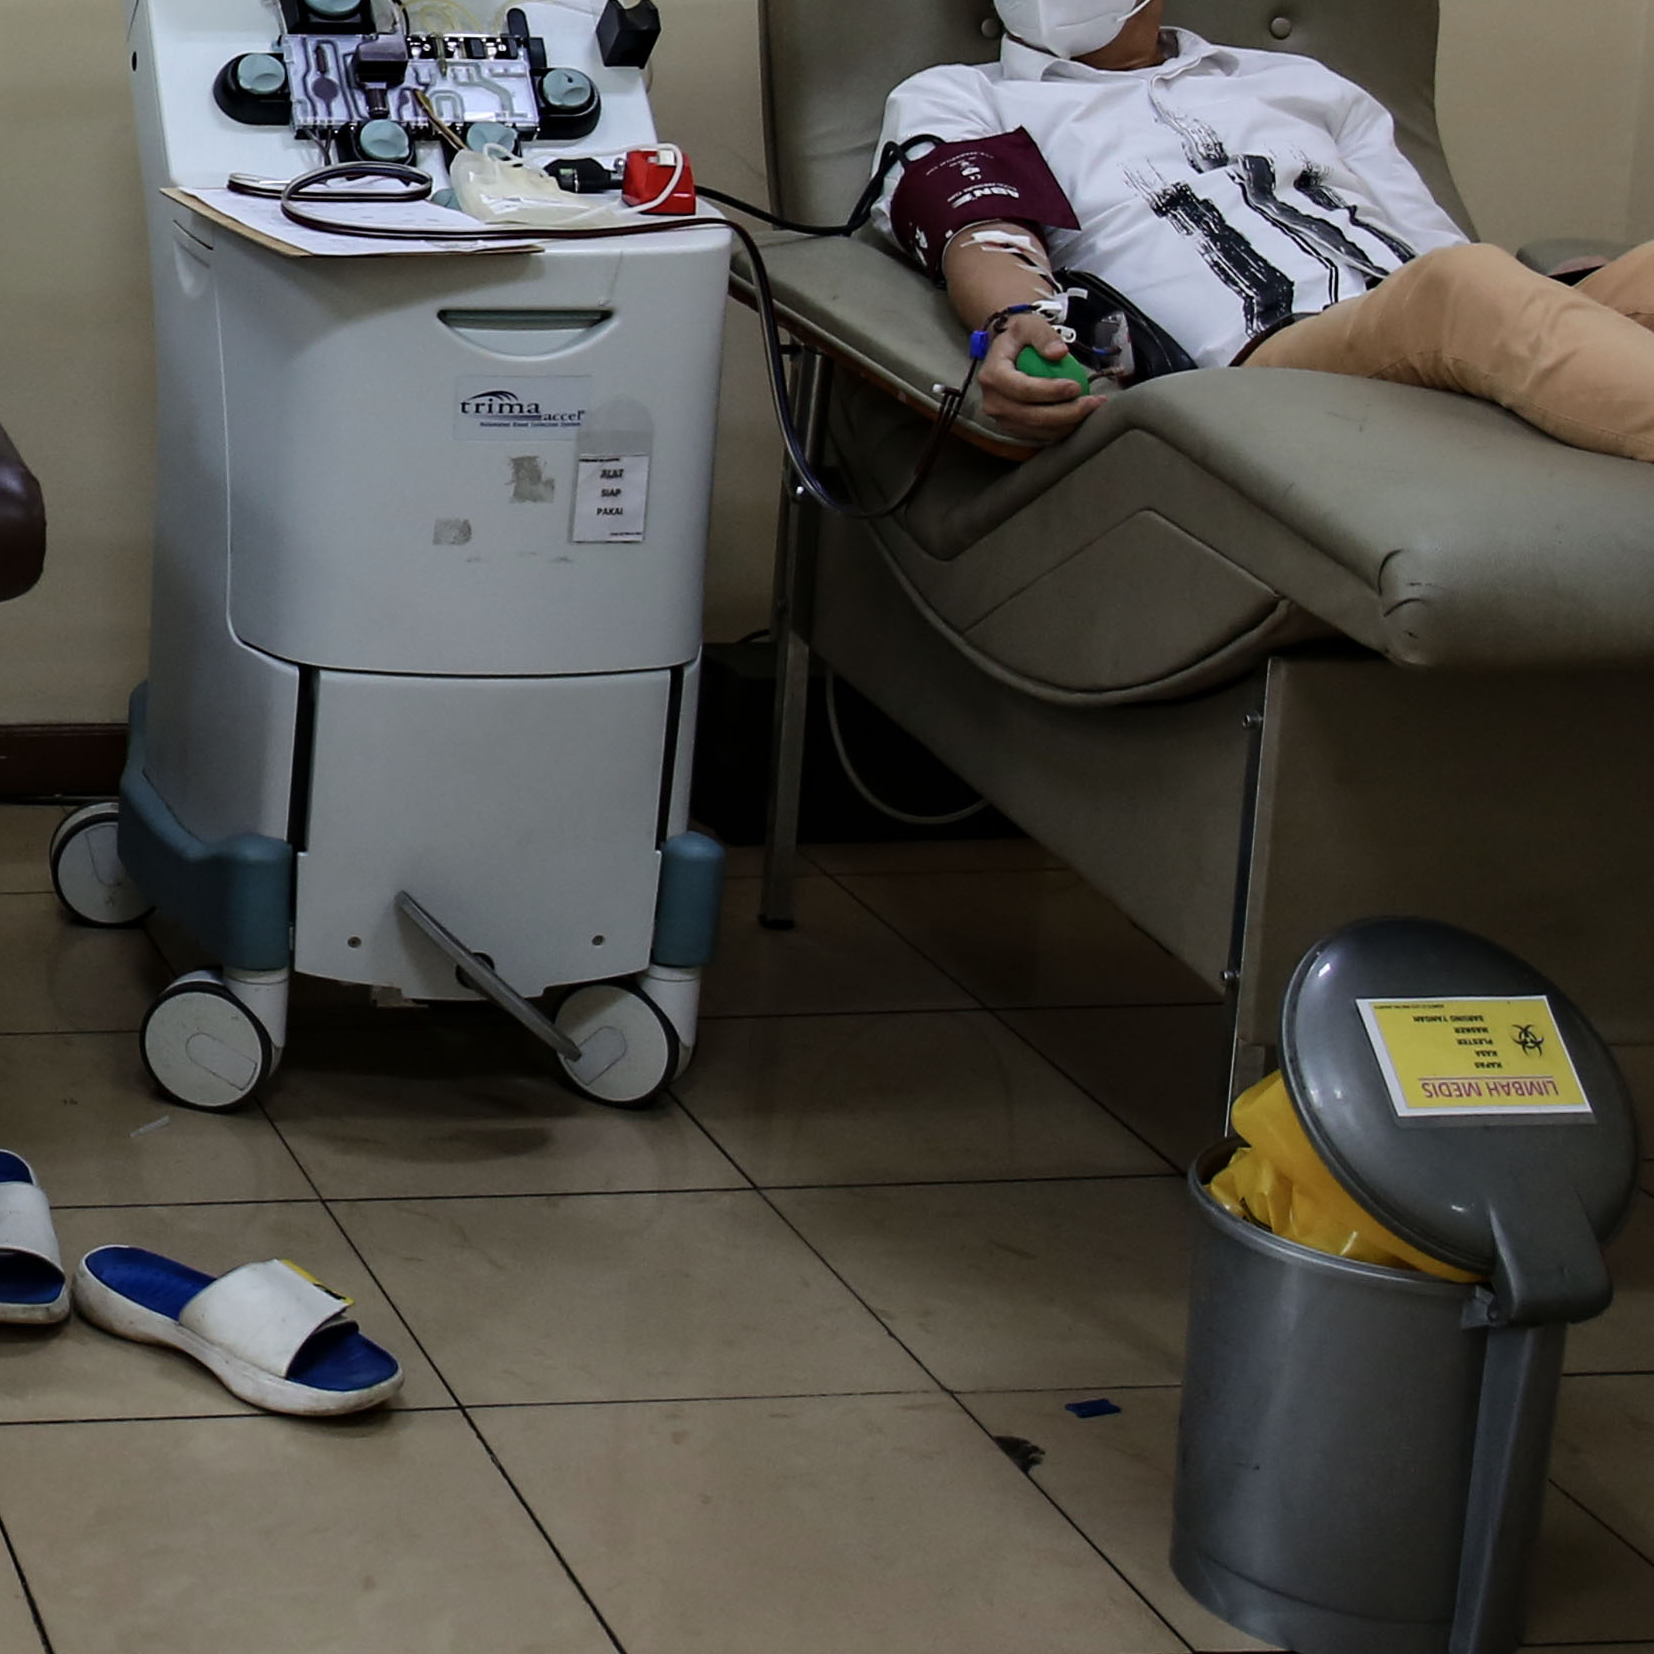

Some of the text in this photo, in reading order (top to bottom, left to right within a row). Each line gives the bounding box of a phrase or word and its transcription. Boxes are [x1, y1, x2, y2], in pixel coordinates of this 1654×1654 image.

[460, 398, 540, 414] trima
[600, 488, 622, 497] SIAP
[596, 507, 624, 516] PAKAI
[1421, 1080, 1559, 1098] LIMBAH MEDIS
